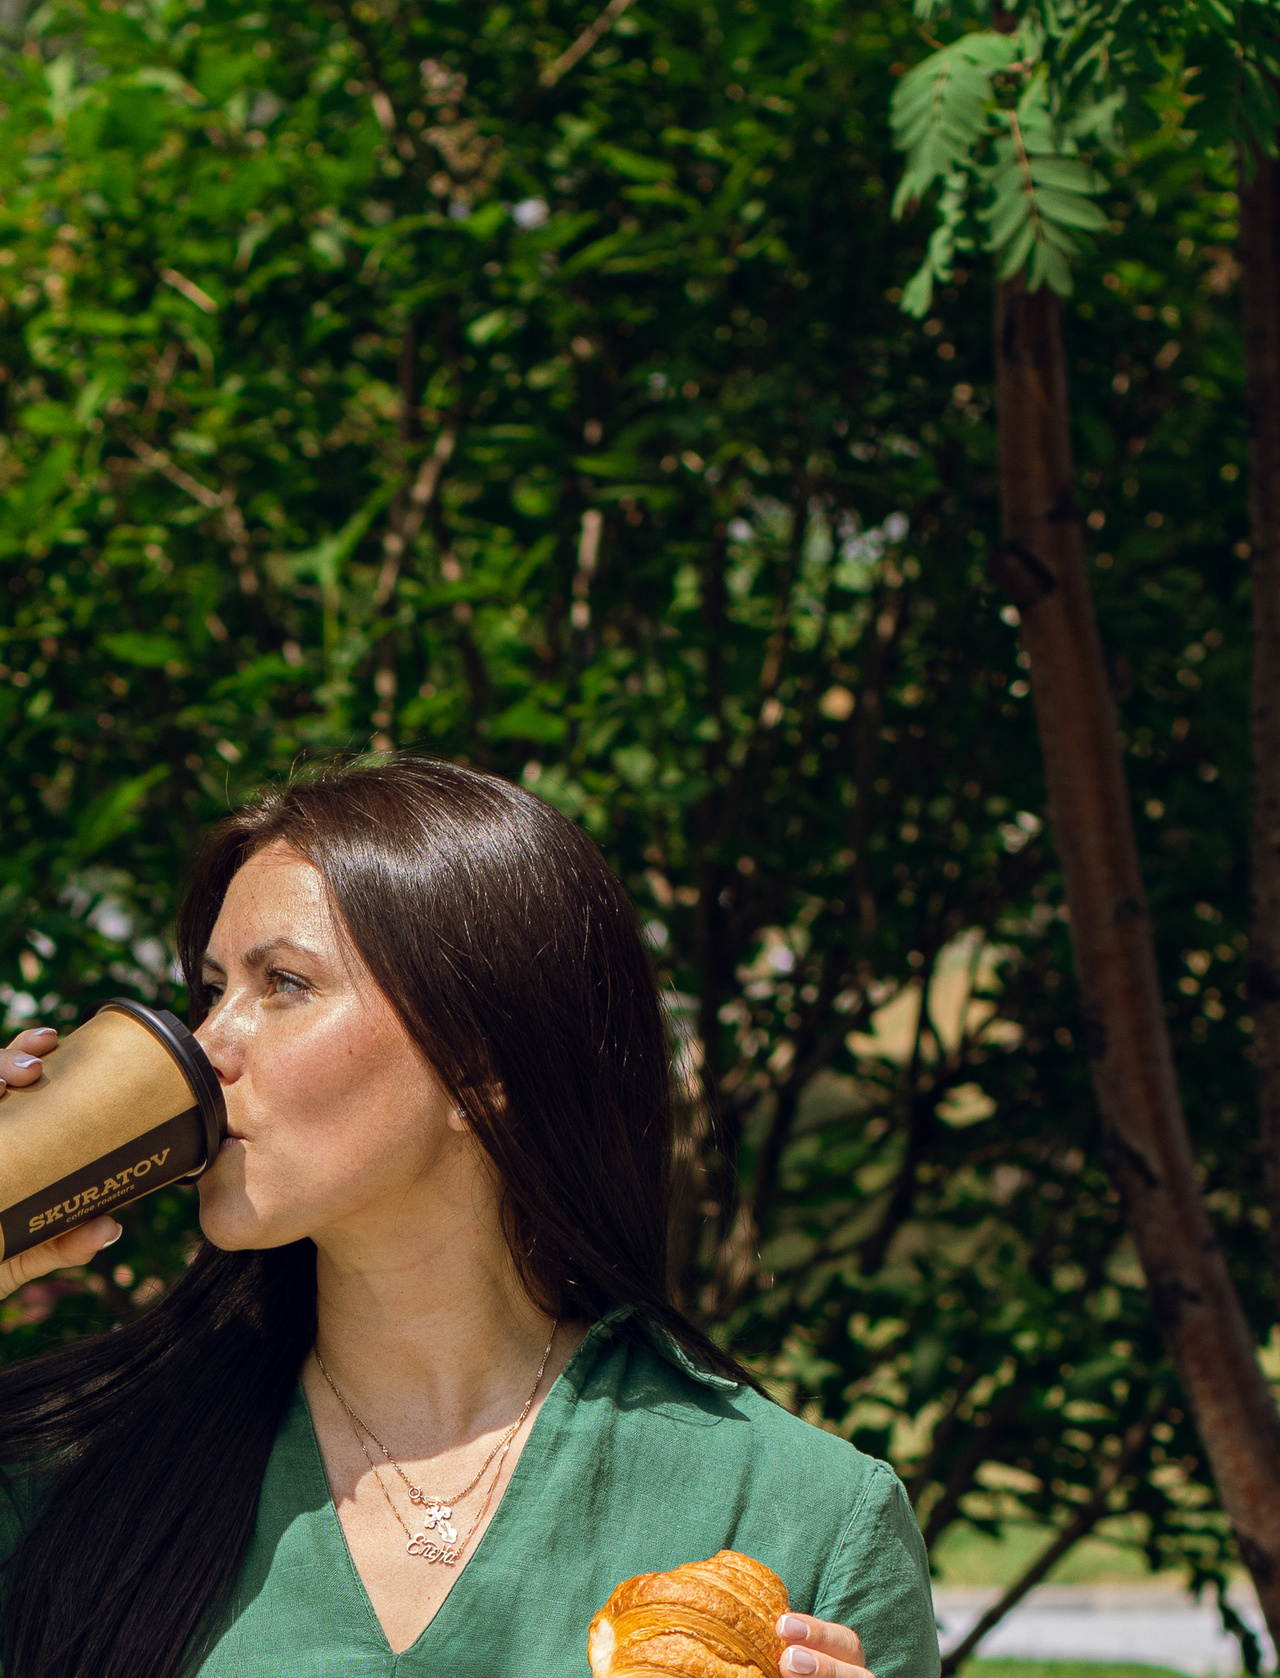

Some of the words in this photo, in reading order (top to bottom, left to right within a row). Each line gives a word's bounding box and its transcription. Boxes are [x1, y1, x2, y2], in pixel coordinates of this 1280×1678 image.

[28, 1147, 170, 1234] SKURATOV
[66, 1205, 95, 1223] coffee
[97, 1184, 135, 1208] roasters
